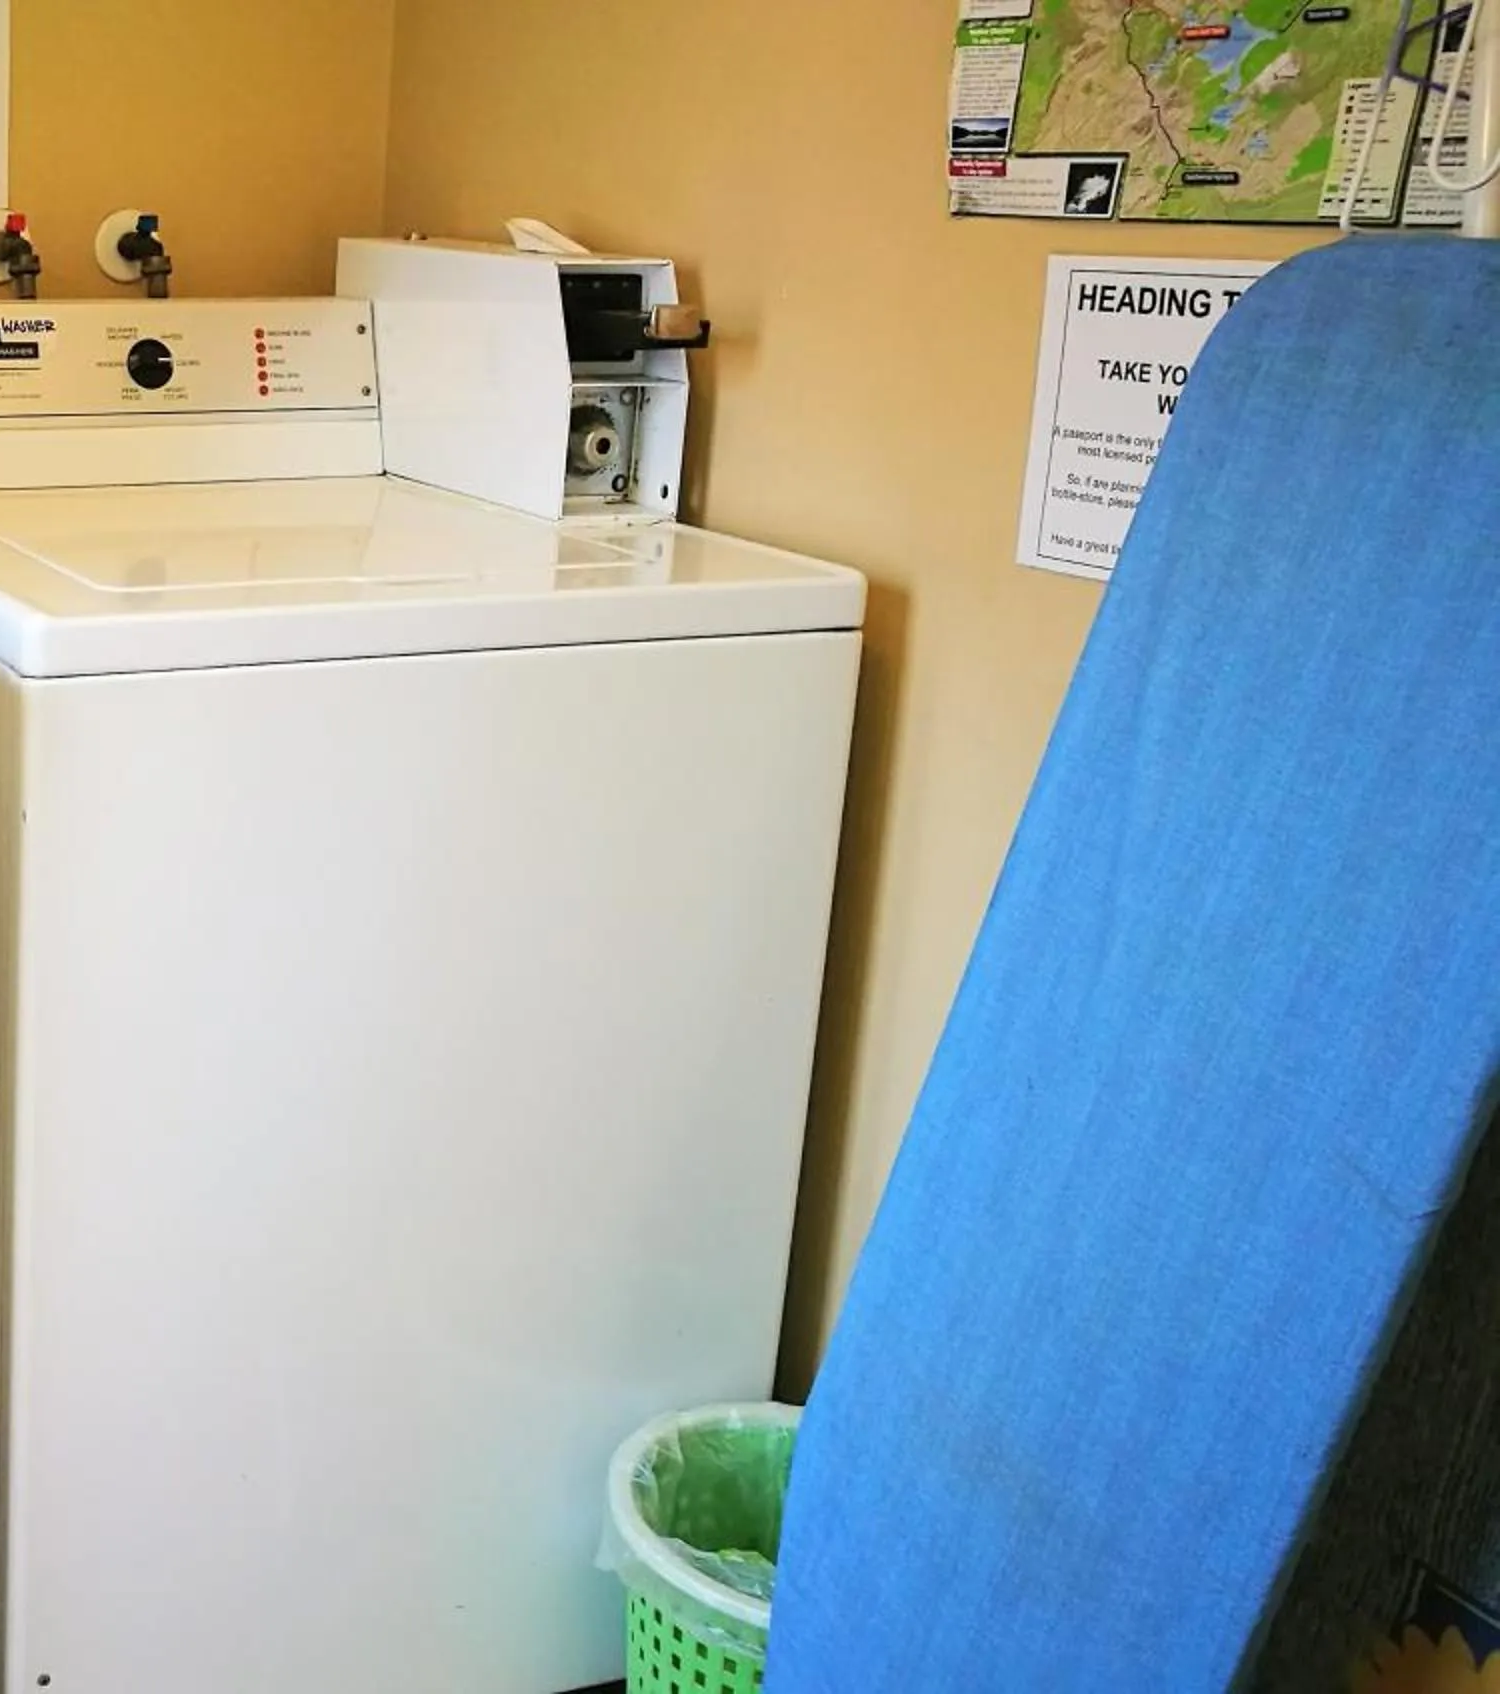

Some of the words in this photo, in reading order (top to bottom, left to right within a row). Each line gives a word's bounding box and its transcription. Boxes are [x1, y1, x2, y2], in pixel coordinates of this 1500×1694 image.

[1078, 283, 1211, 318] HEADING
[1, 317, 56, 333] WASHER
[1098, 359, 1152, 383] TAKE
[1158, 363, 1188, 386] YO
[1157, 394, 1179, 415] W
[1062, 427, 1103, 443] passport
[1105, 432, 1114, 442] is
[1116, 431, 1131, 445] the
[1134, 436, 1155, 450] only
[1077, 445, 1101, 459] most
[1104, 447, 1143, 463] licensed
[1092, 479, 1108, 490] are
[1051, 533, 1074, 548] Have
[1076, 538, 1082, 549] a
[1084, 540, 1109, 554] great
